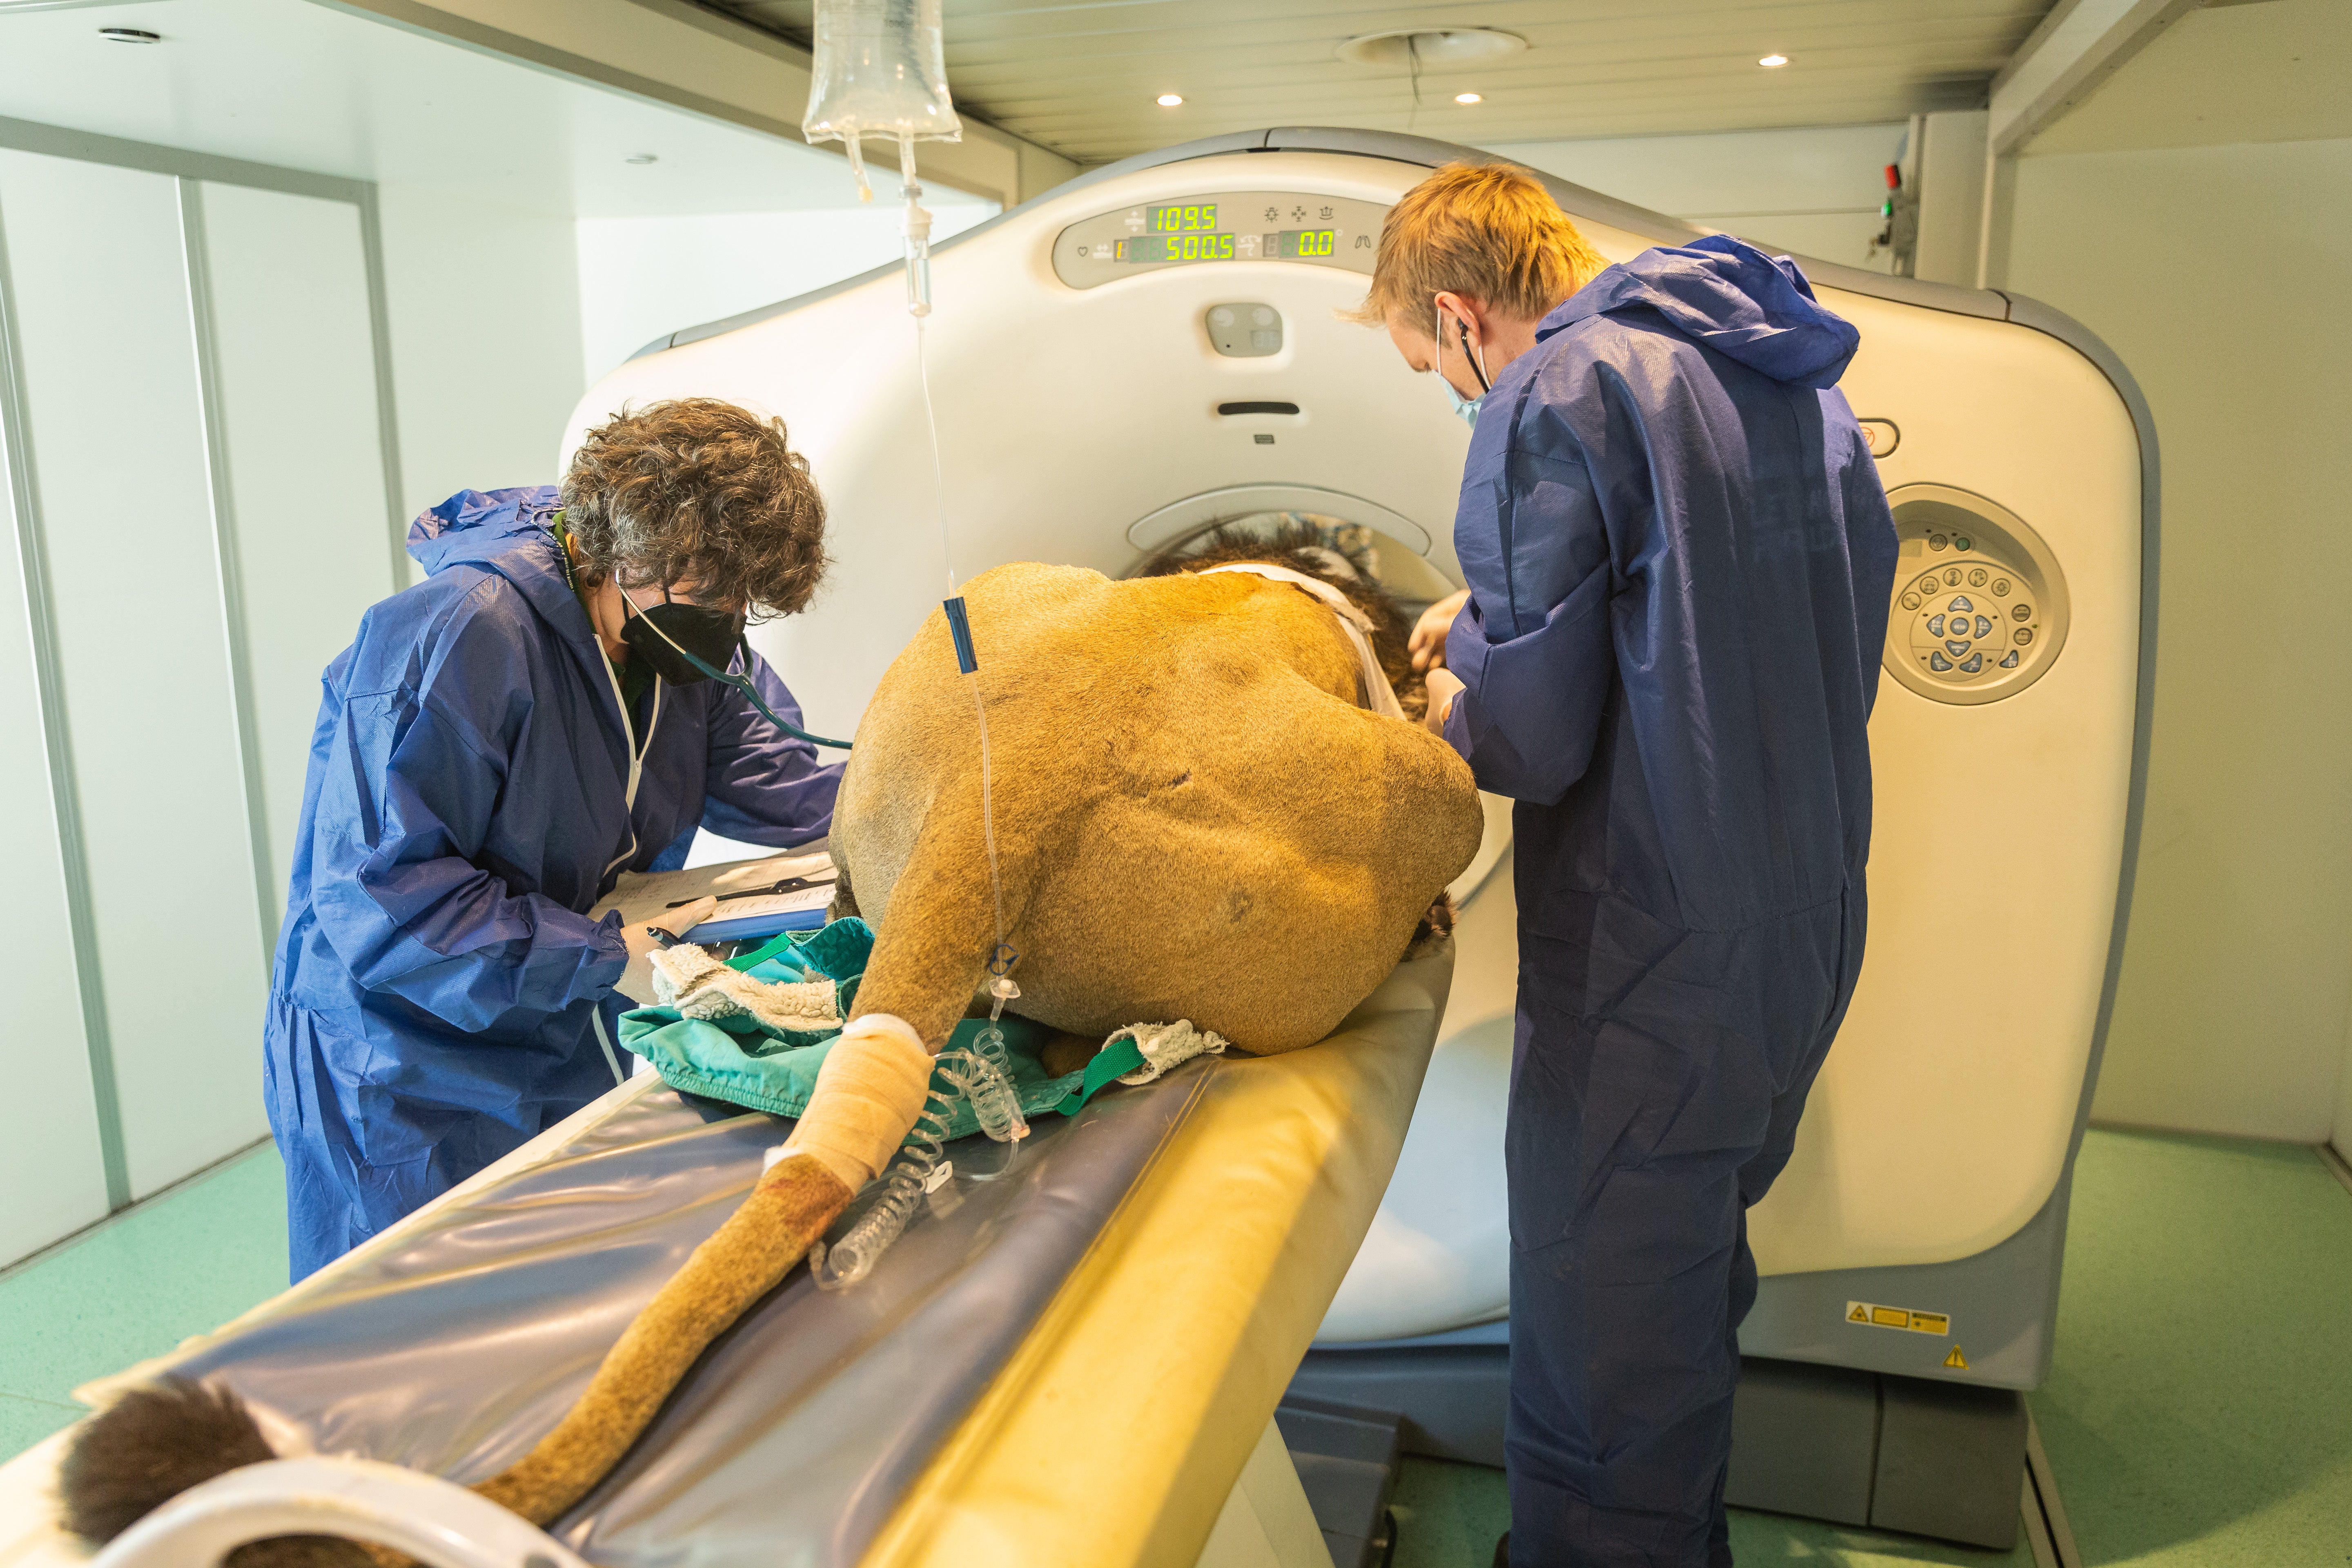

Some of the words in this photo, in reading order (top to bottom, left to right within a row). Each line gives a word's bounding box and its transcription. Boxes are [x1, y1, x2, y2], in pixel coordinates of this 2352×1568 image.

[1157, 205, 1215, 231] 109.5
[1167, 234, 1233, 260] 500.5
[1298, 231, 1333, 256] 0.0
